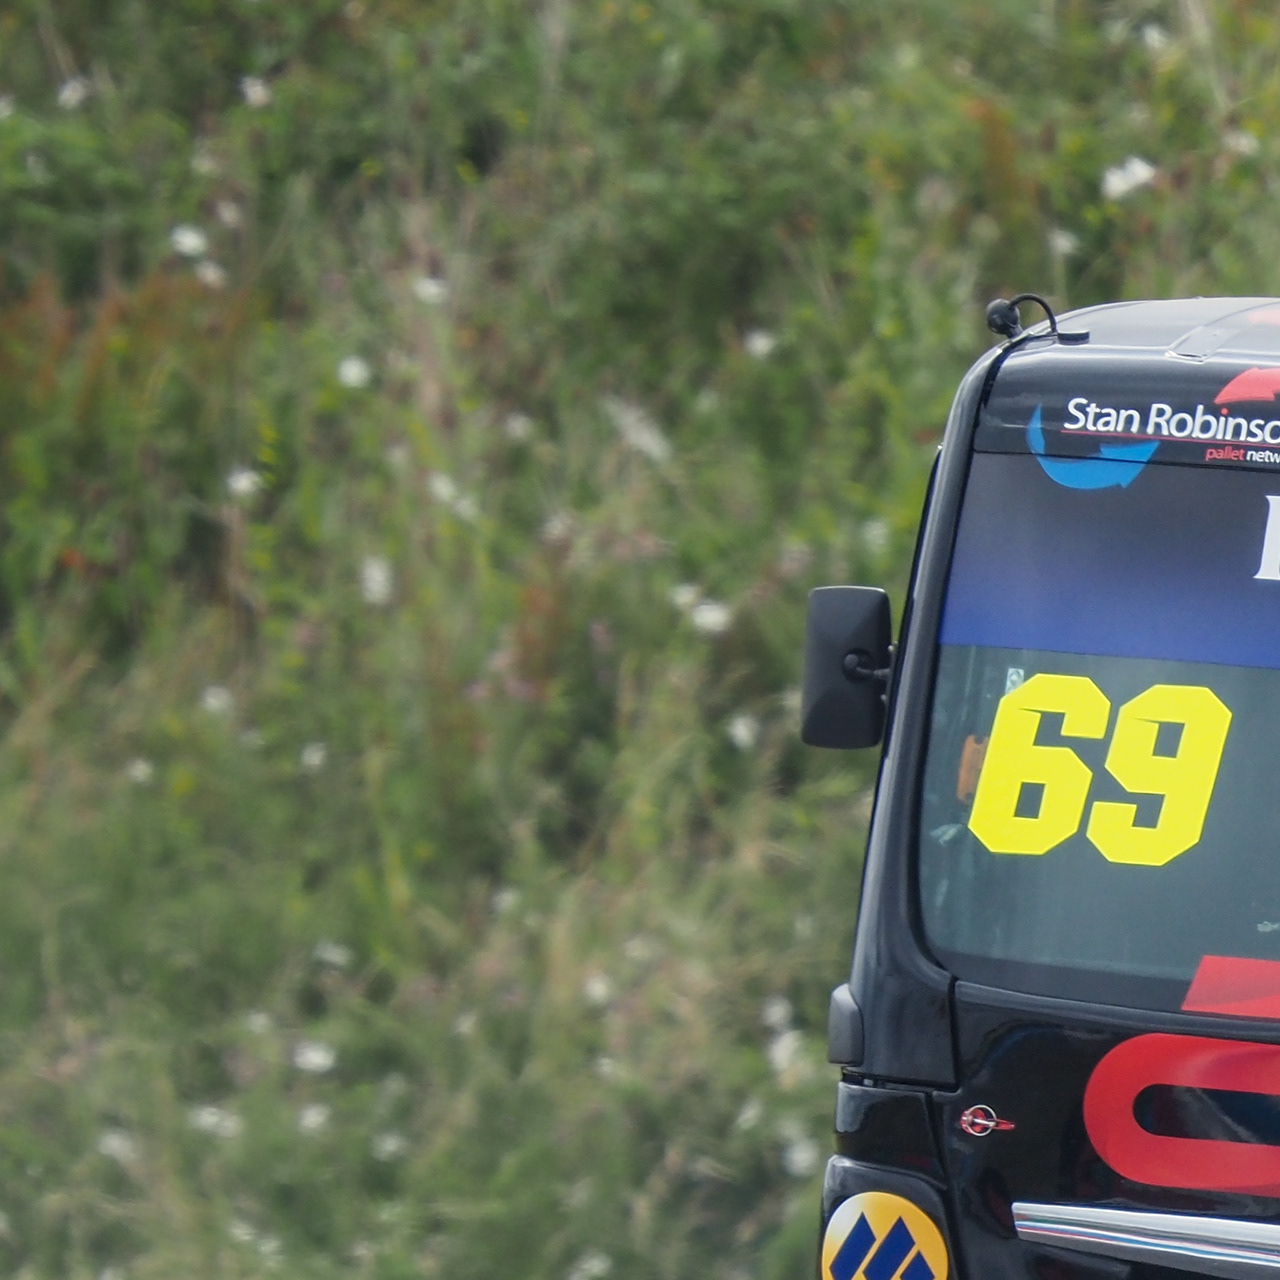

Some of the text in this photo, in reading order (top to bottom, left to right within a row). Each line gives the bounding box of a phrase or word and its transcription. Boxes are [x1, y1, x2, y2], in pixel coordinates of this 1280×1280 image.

[1063, 397, 1141, 434] Stan
[1205, 446, 1244, 463] pallet
[967, 673, 1233, 867] 69
